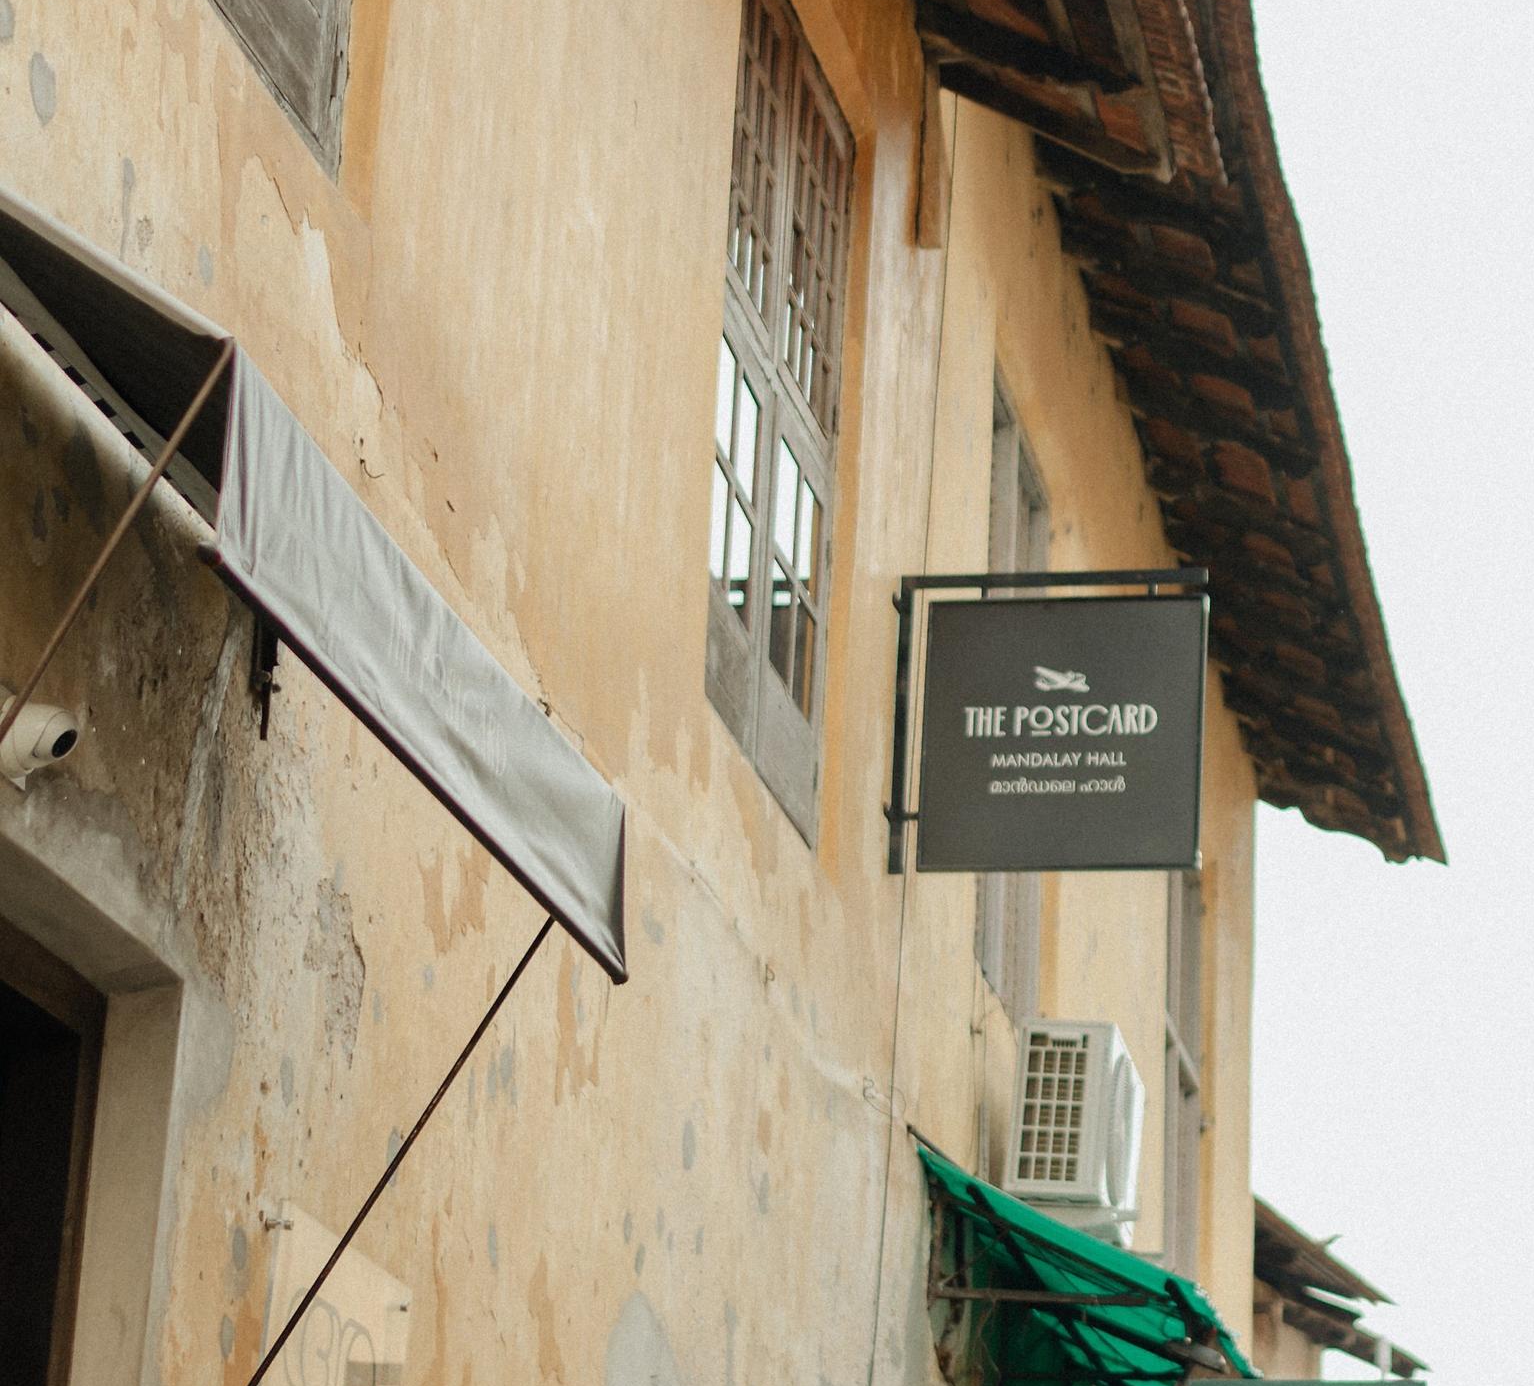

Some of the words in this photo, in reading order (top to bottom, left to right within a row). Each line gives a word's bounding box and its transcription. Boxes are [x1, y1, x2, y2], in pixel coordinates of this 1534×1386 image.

[964, 706, 1007, 738] THE
[1013, 704, 1159, 737] POSTCARD
[991, 752, 1082, 768] MANDALAY
[1087, 750, 1127, 767] HALL
[1080, 774, 1127, 794] ഹാൾ
